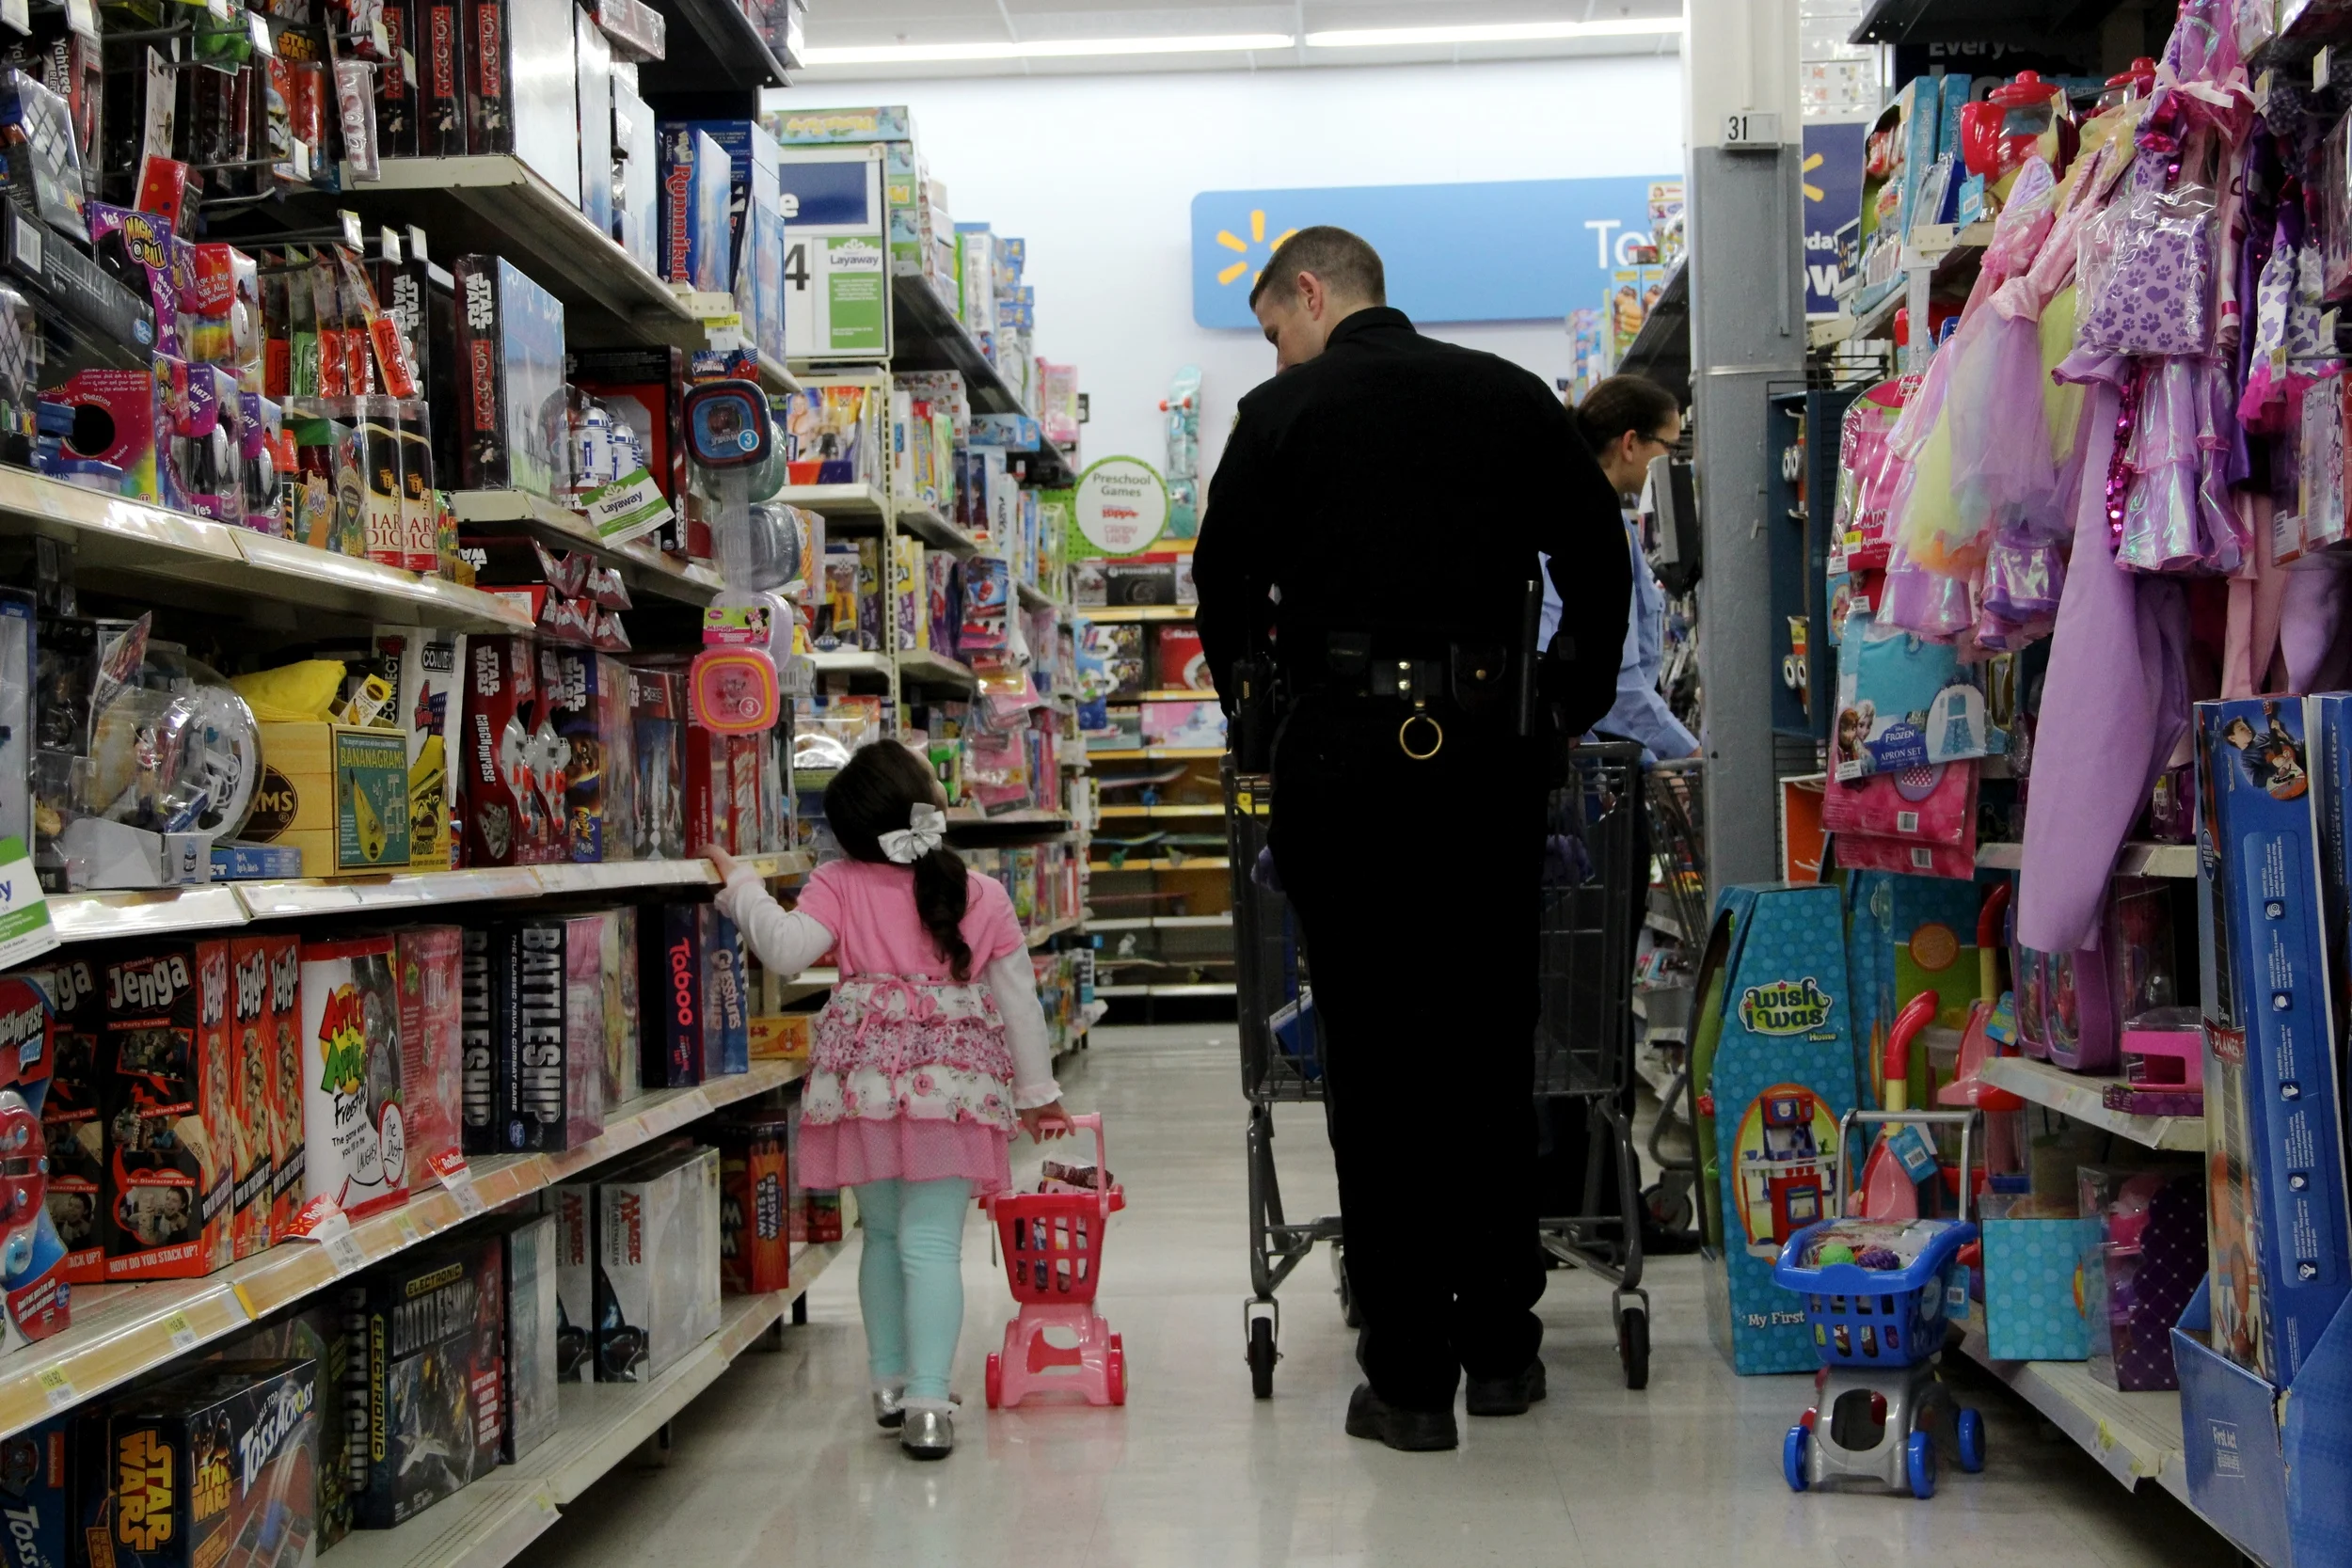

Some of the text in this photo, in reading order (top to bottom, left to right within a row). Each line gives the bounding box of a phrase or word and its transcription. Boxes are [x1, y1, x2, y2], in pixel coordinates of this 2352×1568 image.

[283, 32, 316, 48] STAR
[51, 38, 72, 94] Yahtzee
[1727, 116, 1749, 141] 31
[102, 212, 119, 227] Yes
[124, 217, 154, 245] MAGIC
[666, 165, 692, 283] Rummikub
[143, 241, 167, 269] BALL
[830, 254, 880, 267] Layaway
[466, 273, 481, 330] WARS
[478, 273, 494, 330] STAR
[161, 324, 174, 339] No
[82, 391, 112, 407] Question
[190, 383, 213, 402] Hazy
[744, 433, 753, 447] 3
[1092, 472, 1152, 486] Preschool
[1101, 485, 1141, 498] Games
[193, 503, 212, 516] Yes
[599, 489, 644, 515] Layaway
[476, 645, 489, 696] WARS
[485, 645, 500, 697] STAR
[572, 657, 587, 712] STAR
[745, 700, 754, 713] 3
[1885, 729, 1915, 744] FROZEN
[341, 747, 405, 769] BANANAGRAMS
[1881, 747, 1922, 762] APRON SET
[2331, 721, 2344, 887] acoustic guitar
[123, 956, 154, 970] Classic
[109, 955, 190, 1009] Jenga
[201, 951, 228, 1024] Jenga
[235, 948, 267, 1019] Jenga
[270, 944, 298, 1013] Jenga
[669, 937, 694, 1027] Taboo
[1746, 979, 1831, 1008] wish
[109, 1018, 169, 1031] The Party Crusher
[522, 927, 562, 1124] BATTLESHIP
[1756, 1008, 1824, 1029] was
[1808, 1032, 1837, 1042] Home
[2213, 1031, 2241, 1059] PLANES
[142, 1103, 192, 1117] The Block Jock
[333, 1082, 368, 1129] Freestyle
[332, 1134, 344, 1148] The
[344, 1129, 358, 1145] game
[385, 1116, 398, 1138] The
[342, 1148, 352, 1159] you
[140, 1178, 174, 1186] Distractor
[757, 1195, 768, 1239] WITS
[767, 1174, 778, 1240] WAGERS
[86, 1250, 102, 1266] UP?
[109, 1243, 199, 1274] HOW DO YOU STACK UP?
[406, 1264, 462, 1295] ELECTRONIC
[1748, 1310, 1805, 1329] My First
[267, 1390, 278, 1407] TOP
[373, 1319, 384, 1456] ELECTRONIC
[240, 1381, 314, 1501] TOSS ACROSS
[2213, 1426, 2237, 1449] First Act
[119, 1430, 146, 1551] WARS
[146, 1430, 173, 1551] STAR
[193, 1460, 233, 1497] STAR
[193, 1480, 233, 1524] WARS
